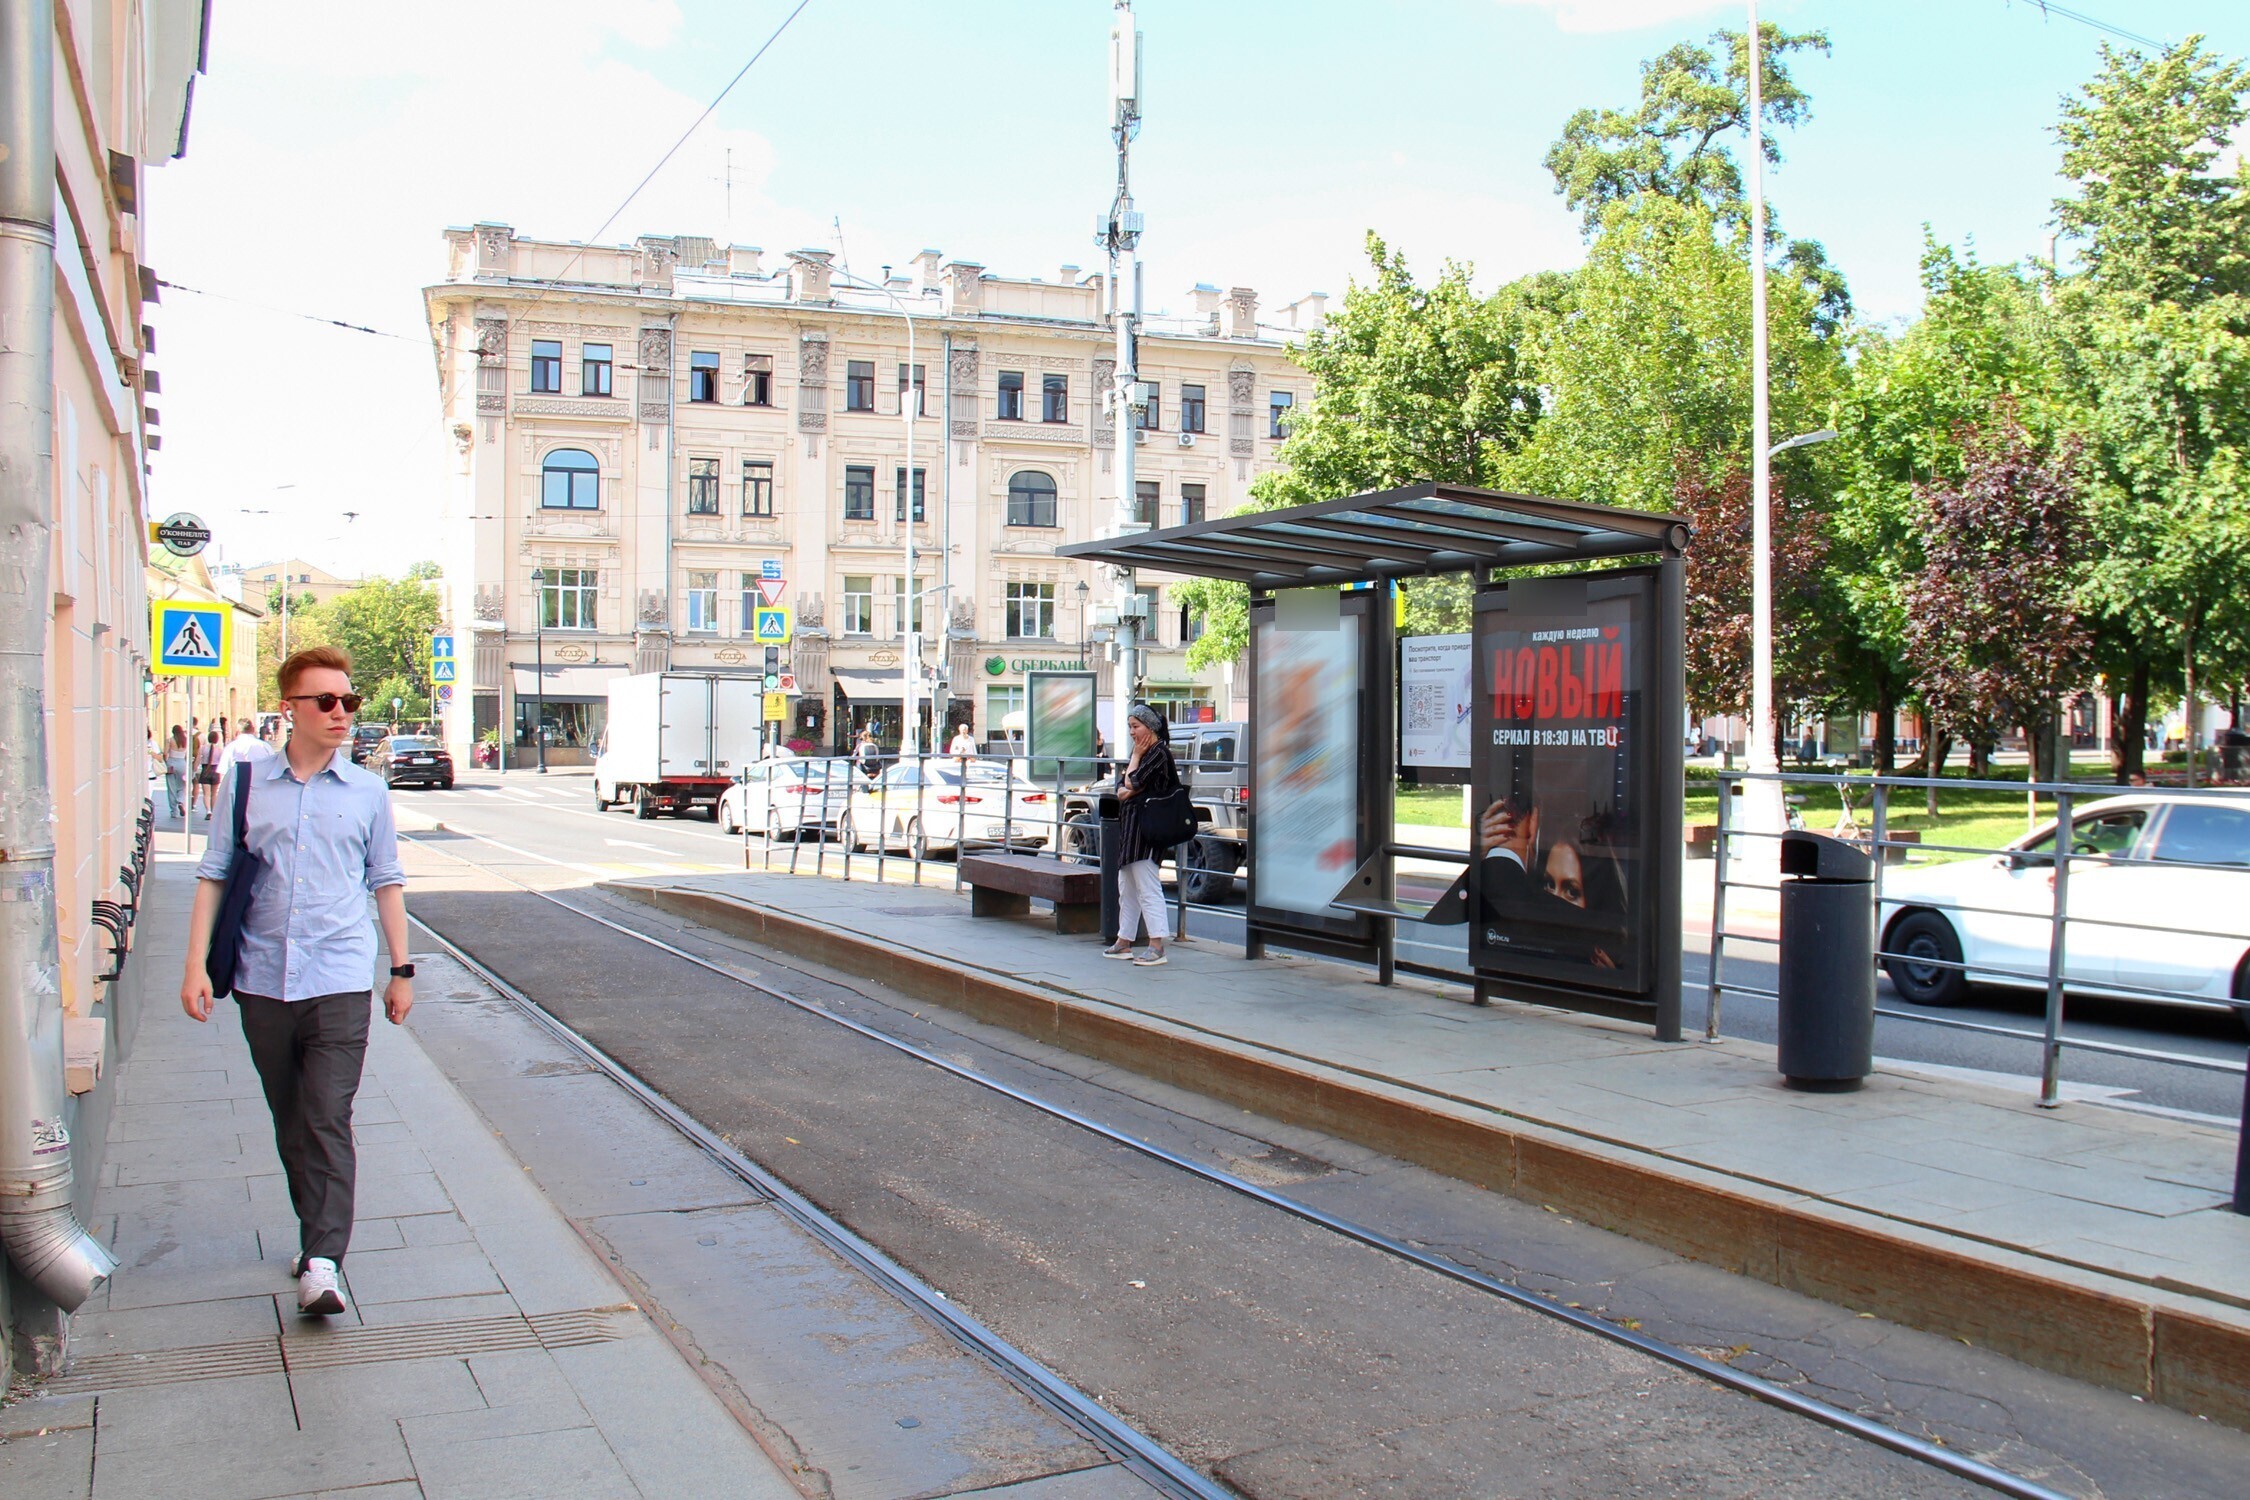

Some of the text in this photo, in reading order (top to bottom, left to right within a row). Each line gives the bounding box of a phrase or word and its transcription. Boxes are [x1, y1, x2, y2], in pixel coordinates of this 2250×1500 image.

[1532, 627, 1599, 642] каждую неделю
[1408, 645, 1437, 654] Посмотрите,
[1438, 644, 1451, 652] когда
[1011, 658, 1087, 671] СБЕРБАНК
[1418, 655, 1441, 663] транспорт
[1493, 626, 1622, 719] НОВЫЙ
[1493, 727, 1618, 747] СЕРИАЛ В 18:30 НА ТВЦ
